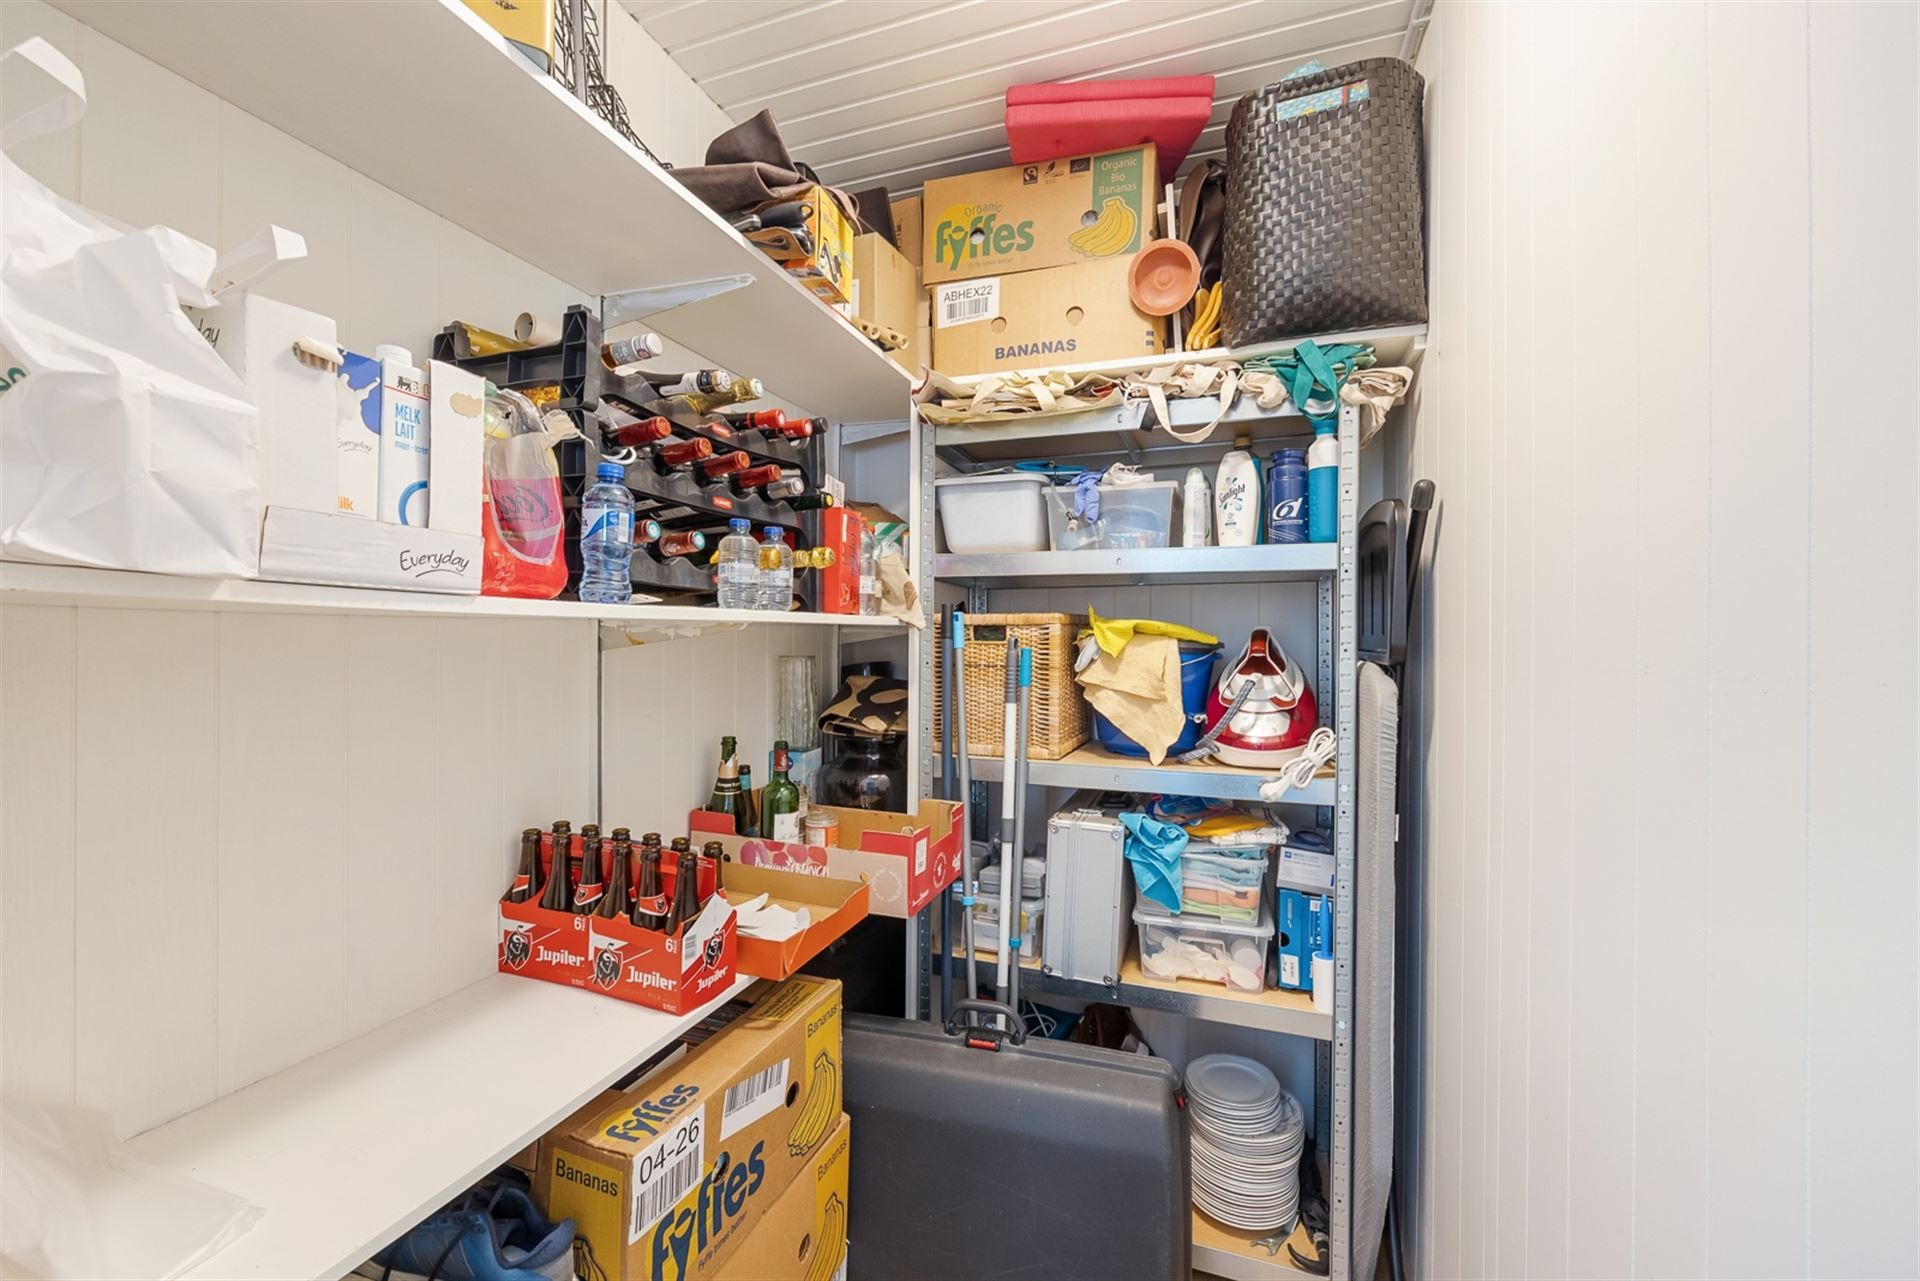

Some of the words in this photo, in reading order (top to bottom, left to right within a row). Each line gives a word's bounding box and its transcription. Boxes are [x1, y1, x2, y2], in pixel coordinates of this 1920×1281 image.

[1101, 157, 1137, 172] Organic
[1098, 183, 1137, 195] Bananas
[1110, 173, 1126, 183] Bio
[964, 201, 1003, 218] Organic
[944, 285, 993, 302] ABHEX22
[994, 339, 1077, 360] BANANAS
[395, 403, 421, 425] MELK
[395, 420, 415, 440] LAIT
[400, 550, 470, 574] Everyday
[573, 917, 582, 931] 6
[665, 938, 673, 953] 6
[535, 946, 584, 968] Jupiler
[625, 966, 677, 992] Jupiler
[696, 966, 728, 993] Jupiler
[807, 1003, 838, 1038] Bananas
[606, 1084, 699, 1143] fyffes
[639, 1117, 699, 1185] 04-26
[817, 1139, 847, 1182] Bananas
[555, 1158, 618, 1197] Bananas
